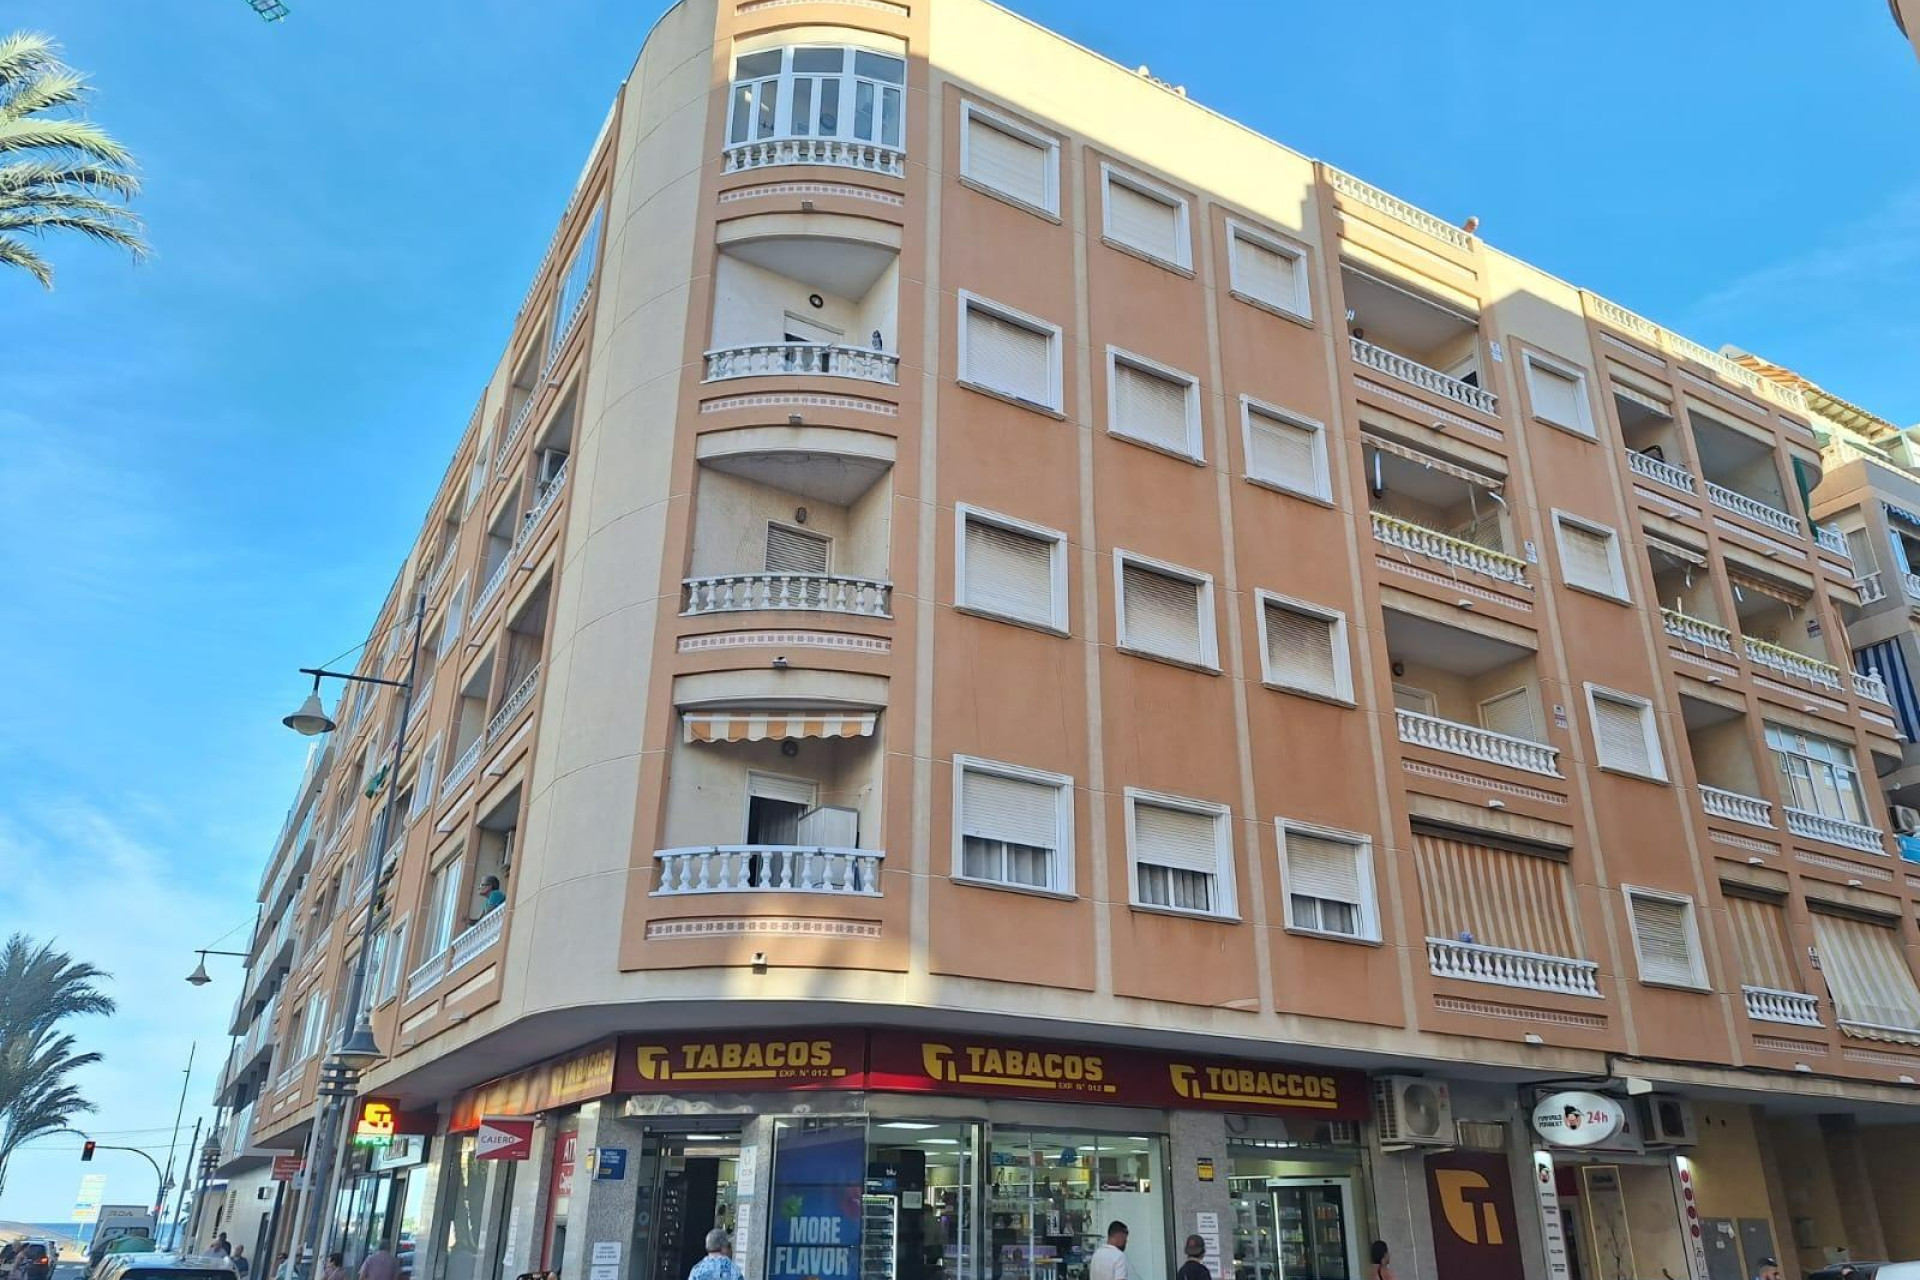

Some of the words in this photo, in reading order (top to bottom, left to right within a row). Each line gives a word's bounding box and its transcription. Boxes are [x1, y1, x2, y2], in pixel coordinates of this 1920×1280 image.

[564, 1049, 611, 1084] TABACOS
[682, 1041, 832, 1069] TABACOS
[966, 1047, 1104, 1081] TABACOS
[1206, 1067, 1337, 1099] TOBACCOS
[1587, 1110, 1609, 1124] 24h
[481, 1135, 516, 1144] CAJERO
[789, 1216, 841, 1243] MORE
[775, 1247, 849, 1275] FLAVOR
